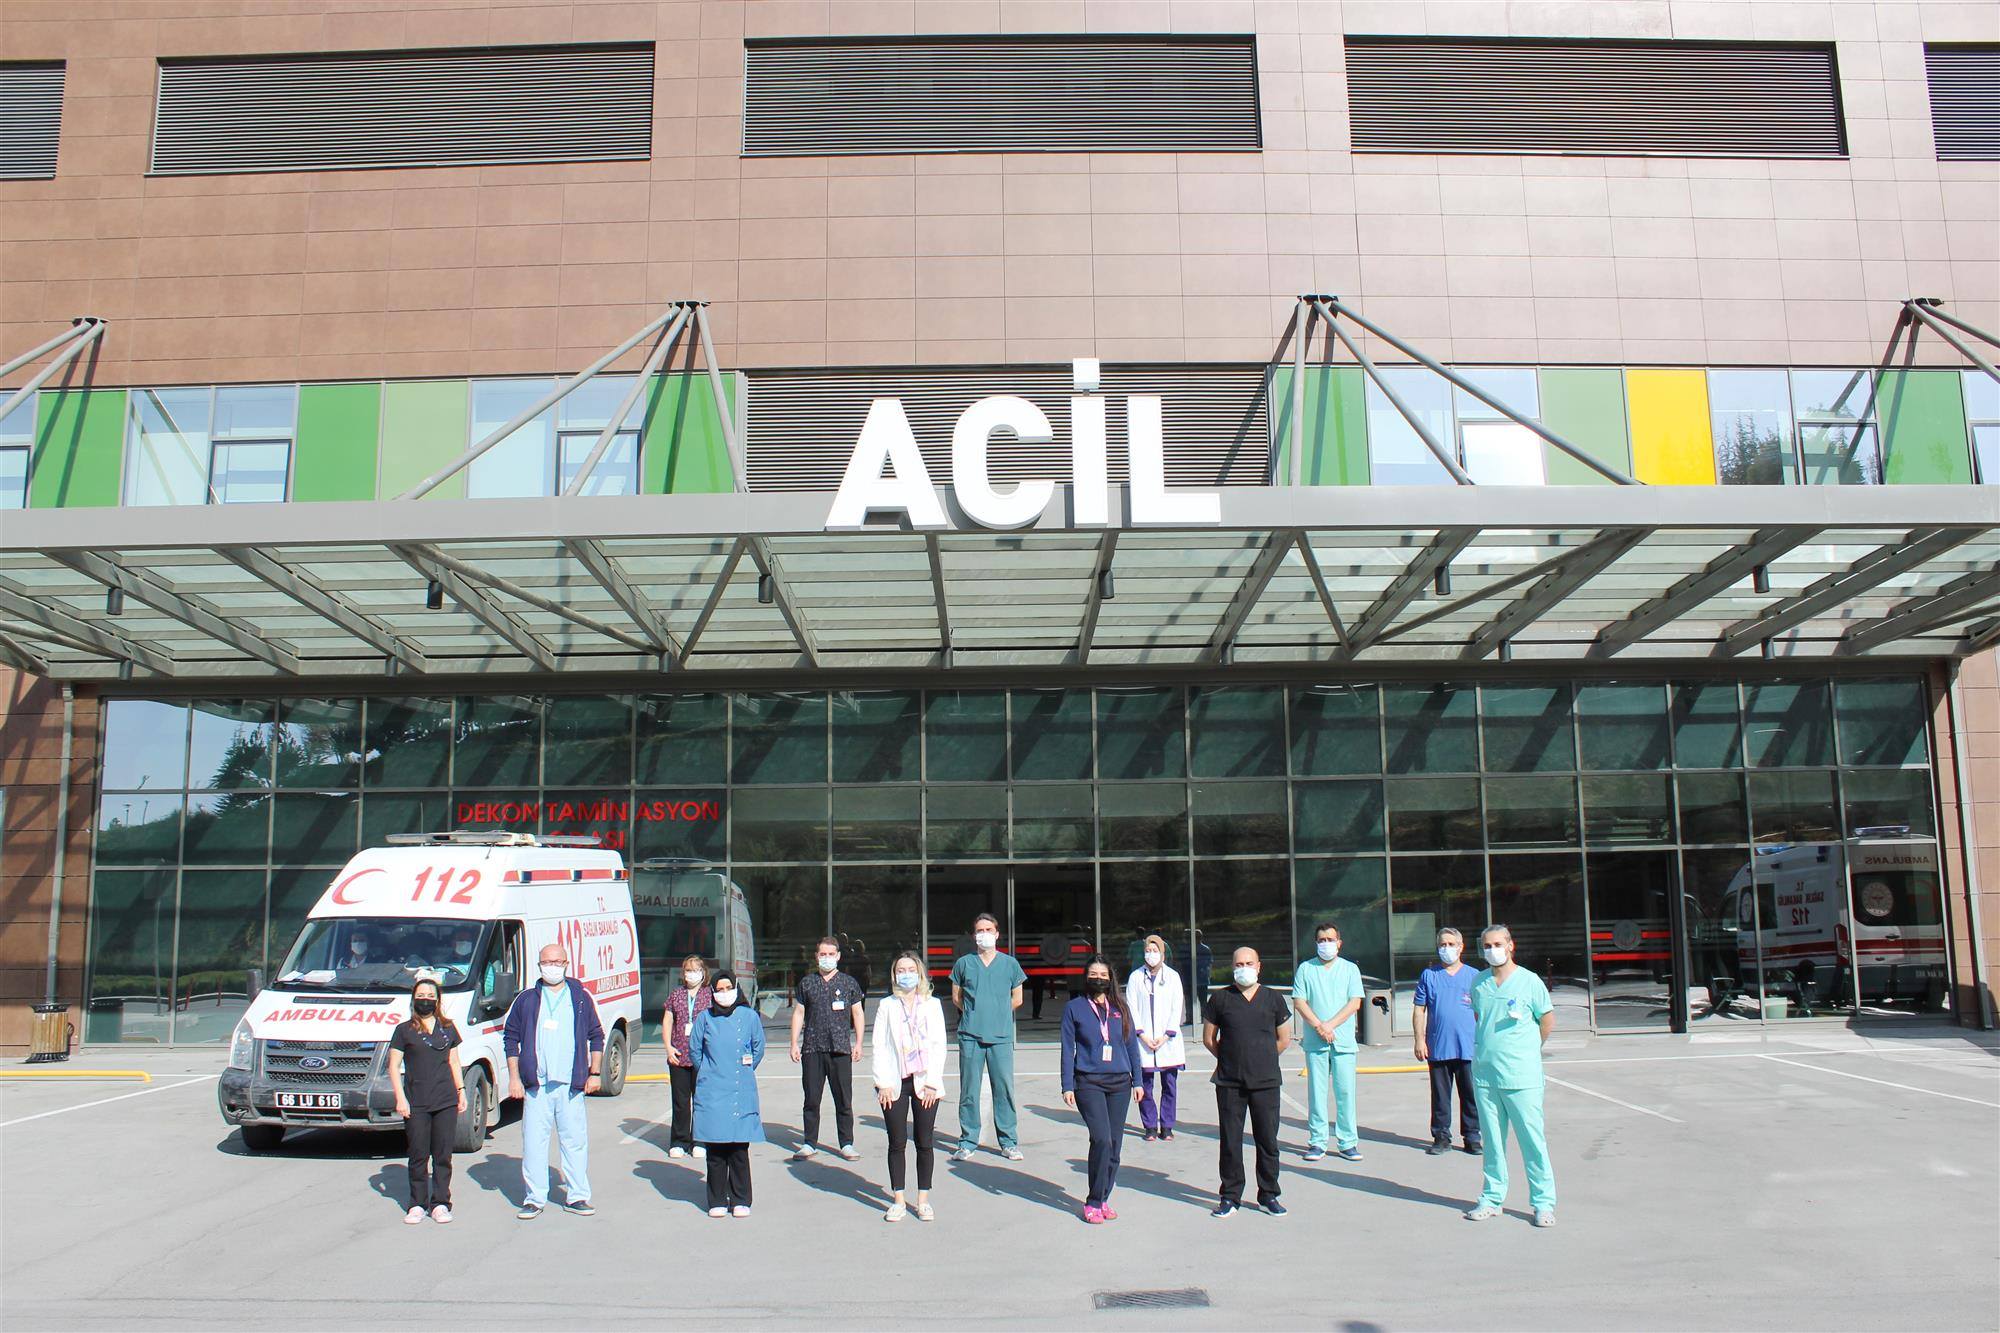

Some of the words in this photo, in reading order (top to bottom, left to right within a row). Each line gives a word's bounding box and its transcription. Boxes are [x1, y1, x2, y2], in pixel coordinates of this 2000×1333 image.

[825, 357, 1222, 531] ACİL
[411, 866, 481, 904] 112
[598, 944, 614, 971] 112
[596, 973, 630, 993] AMBULANS
[263, 1008, 402, 1025] AMBULANS
[304, 1058, 320, 1067] Ford
[281, 1094, 295, 1106] 66
[300, 1095, 313, 1106] LU
[318, 1095, 339, 1107] 616
